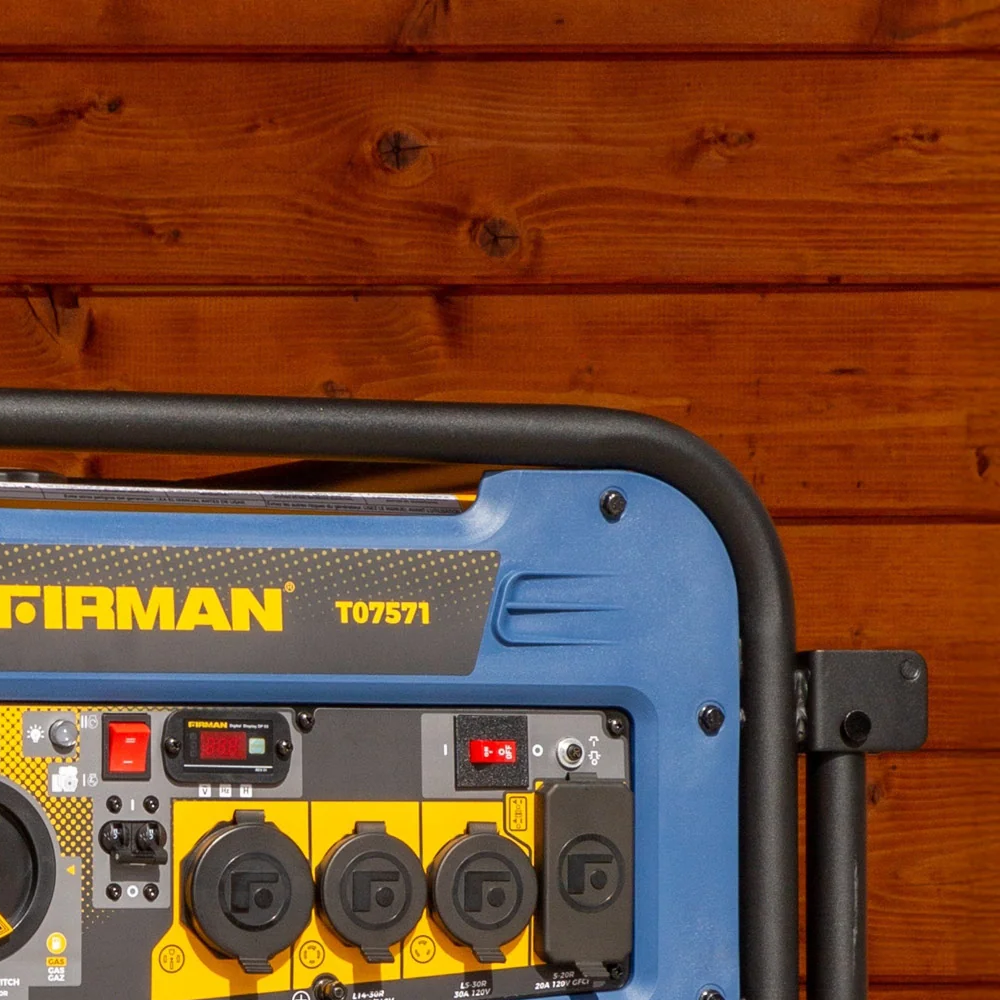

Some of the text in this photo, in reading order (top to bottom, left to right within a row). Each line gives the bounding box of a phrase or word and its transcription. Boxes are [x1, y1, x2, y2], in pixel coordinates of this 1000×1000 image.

[335, 601, 430, 625] T07571
[188, 721, 228, 729] FIRMAN
[48, 974, 65, 982] GAZ
[534, 982, 550, 990] 20A
[552, 980, 571, 989] 120V
[453, 988, 491, 998] 30A 120V
